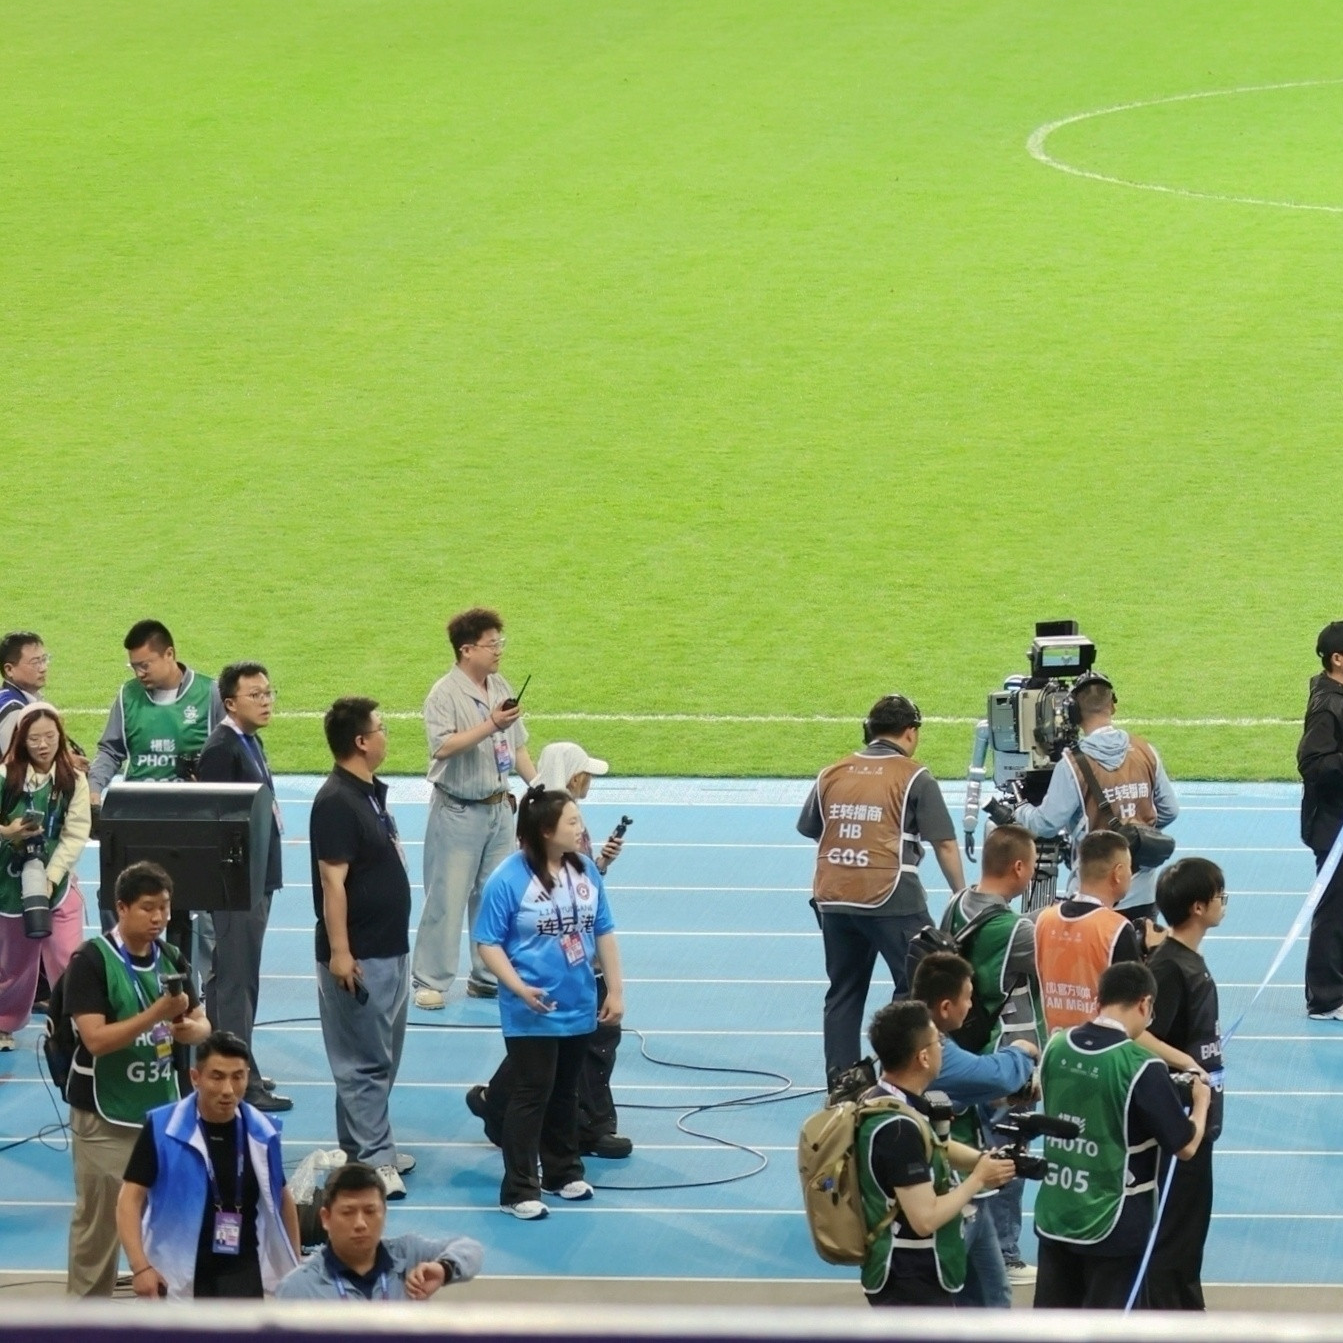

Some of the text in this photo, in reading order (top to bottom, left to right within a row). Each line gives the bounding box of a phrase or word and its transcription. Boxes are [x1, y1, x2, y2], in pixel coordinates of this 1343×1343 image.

[138, 754, 177, 768] PHOT
[829, 803, 883, 823] 主转播商
[838, 824, 863, 840] HB
[827, 848, 870, 867] G06
[536, 914, 595, 937] 连云港
[1046, 982, 1092, 999] 队官方媒体
[126, 1061, 172, 1084] G34
[1044, 1163, 1090, 1195] G05
